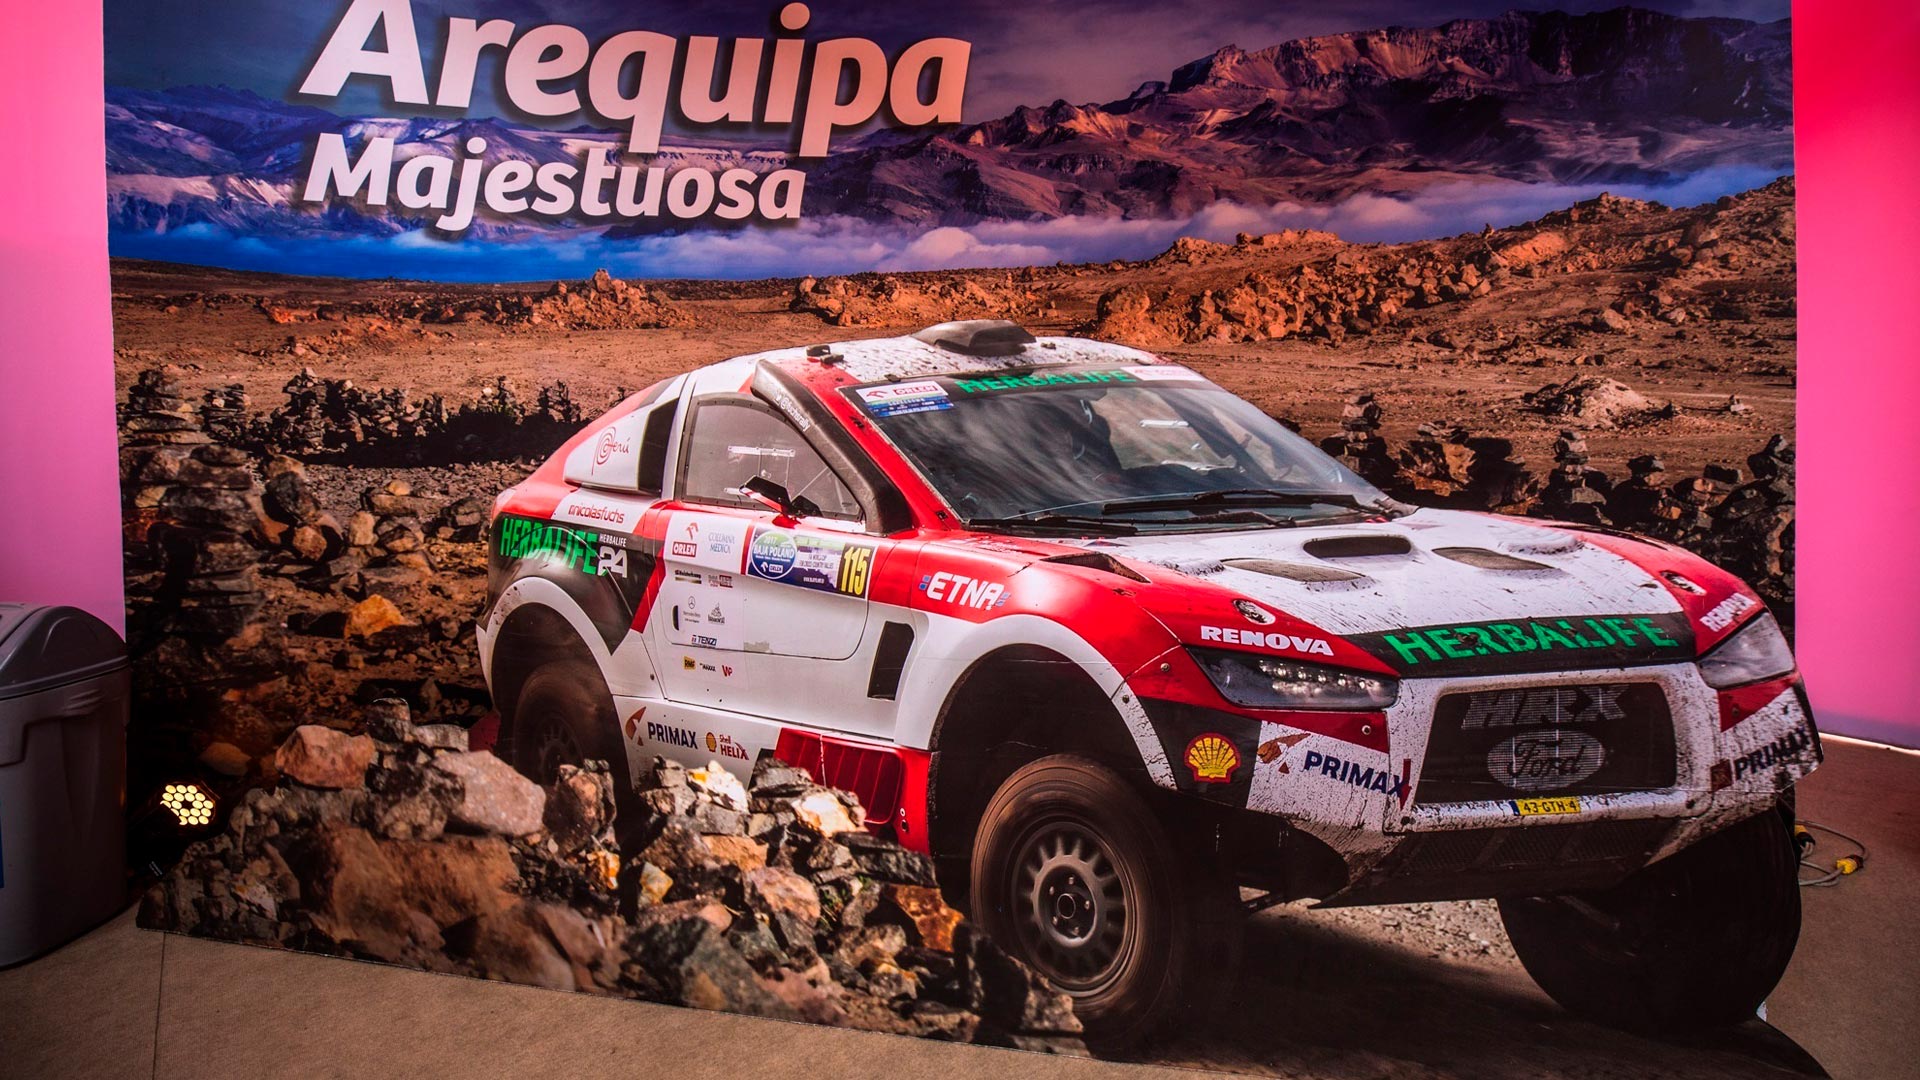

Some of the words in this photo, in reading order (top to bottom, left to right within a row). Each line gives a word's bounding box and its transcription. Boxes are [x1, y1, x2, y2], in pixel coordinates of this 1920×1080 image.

[299, 0, 971, 157] Arequipa
[303, 133, 806, 231] Majestuosa
[955, 370, 1137, 393] HERBALIFE
[499, 518, 599, 575] HERBALIFE
[673, 542, 696, 556] ORLEN
[769, 546, 795, 559] POLAND
[841, 546, 871, 595] 115
[926, 571, 1005, 610] ETNA
[1201, 625, 1334, 656] RENOVA
[1384, 617, 1679, 664] HERBALIFE
[647, 721, 698, 750] PRIMAX
[719, 733, 731, 744] Shell
[720, 742, 750, 761] HELIX
[1303, 750, 1410, 799] PRIMAX
[1506, 738, 1586, 778] Ford
[1523, 800, 1577, 814] 43-GTH-4
